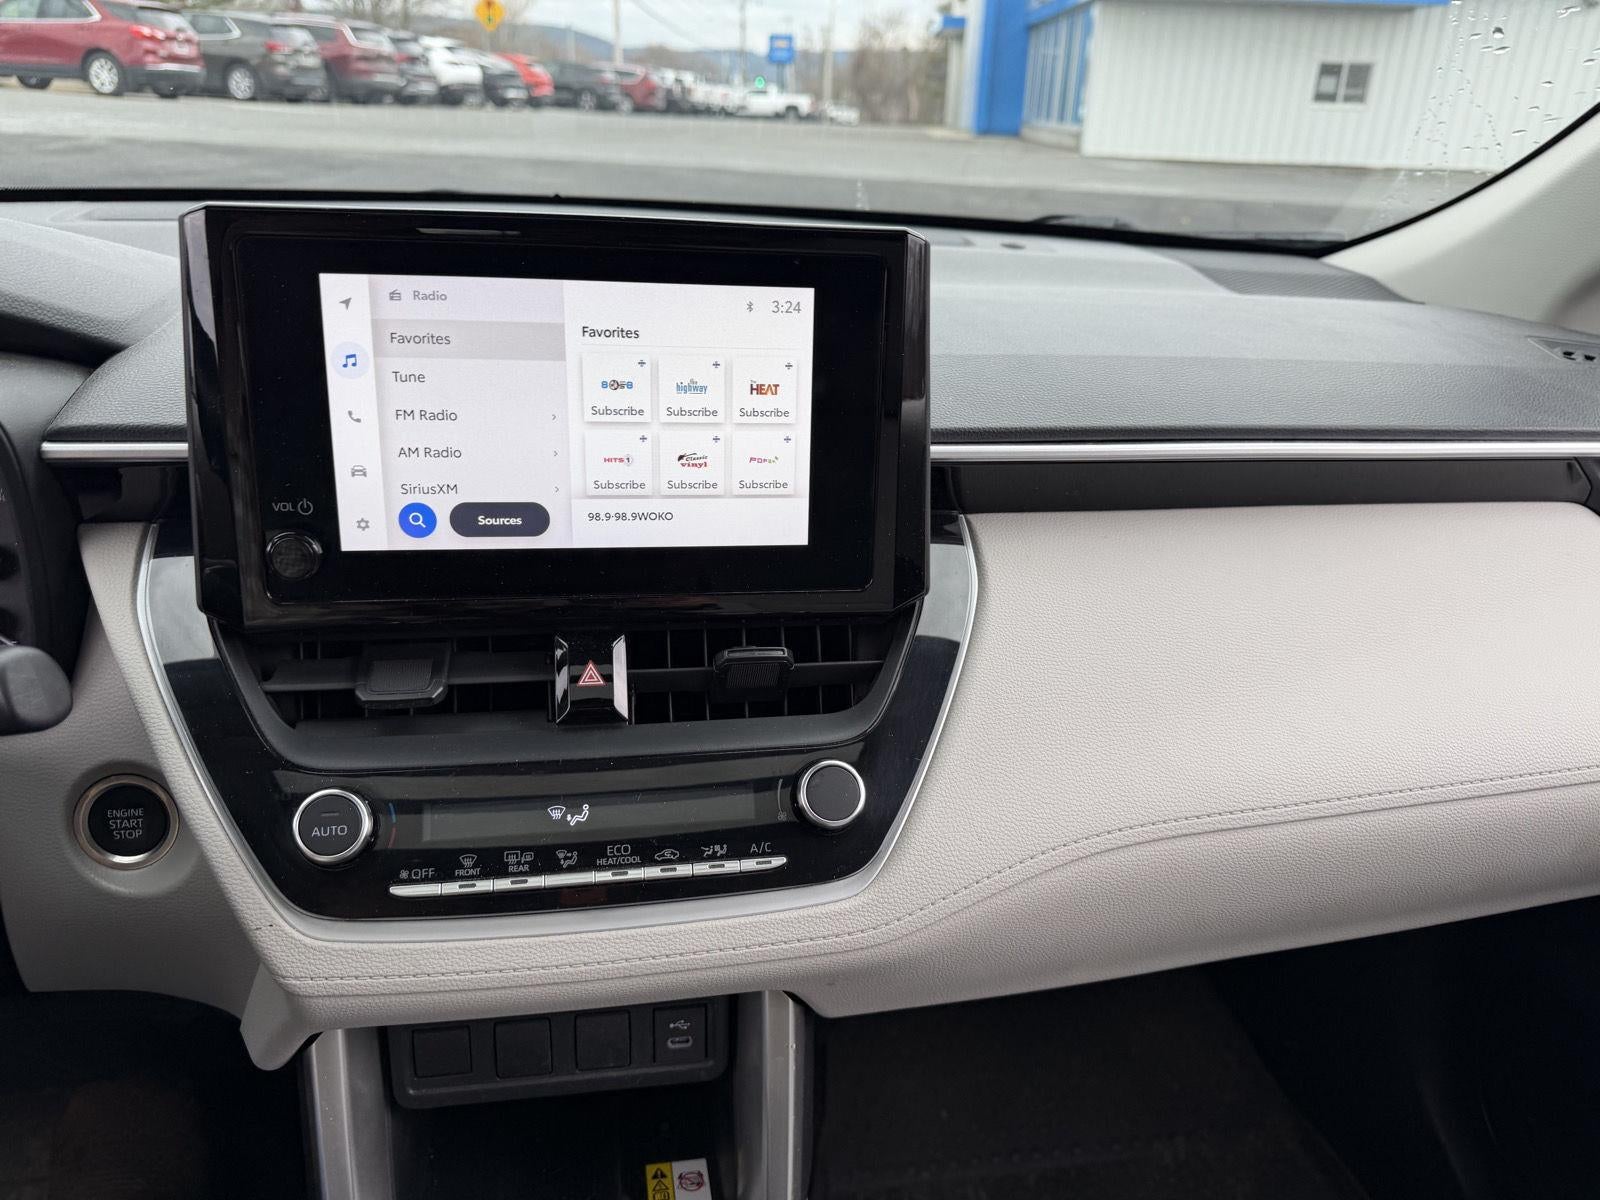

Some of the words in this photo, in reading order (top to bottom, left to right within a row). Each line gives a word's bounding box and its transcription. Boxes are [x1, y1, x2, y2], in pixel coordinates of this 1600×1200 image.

[413, 290, 447, 302] Radio
[771, 300, 801, 314] 3:24
[582, 326, 640, 339] Favorites
[390, 332, 451, 345] Favorites
[392, 371, 426, 383] Tune
[676, 381, 708, 394] highway
[750, 383, 780, 395] HEAT
[395, 409, 415, 421] FM
[419, 409, 458, 421] Radio
[591, 405, 645, 416] Subscribe
[666, 406, 718, 417] Subscribe
[739, 407, 790, 418] Subscribe
[398, 447, 420, 459] AM
[424, 447, 462, 459] Radio
[680, 461, 708, 469] vinyl
[400, 483, 458, 495] SiriusXM
[593, 479, 646, 490] Subscribe
[667, 479, 718, 490] Subscribe
[738, 479, 789, 490] Subscribe
[272, 502, 295, 512] VOL
[477, 515, 522, 526] Sources
[107, 807, 144, 818] ENGINE
[109, 818, 143, 829] START
[113, 829, 143, 839] STOP
[311, 824, 348, 838] AUTO
[607, 844, 631, 856] ECO
[750, 842, 772, 854] A/C
[596, 855, 642, 866] HEAT/COOL
[411, 868, 435, 879] OFF
[455, 867, 480, 877] FRONT
[508, 864, 530, 873] REAR
